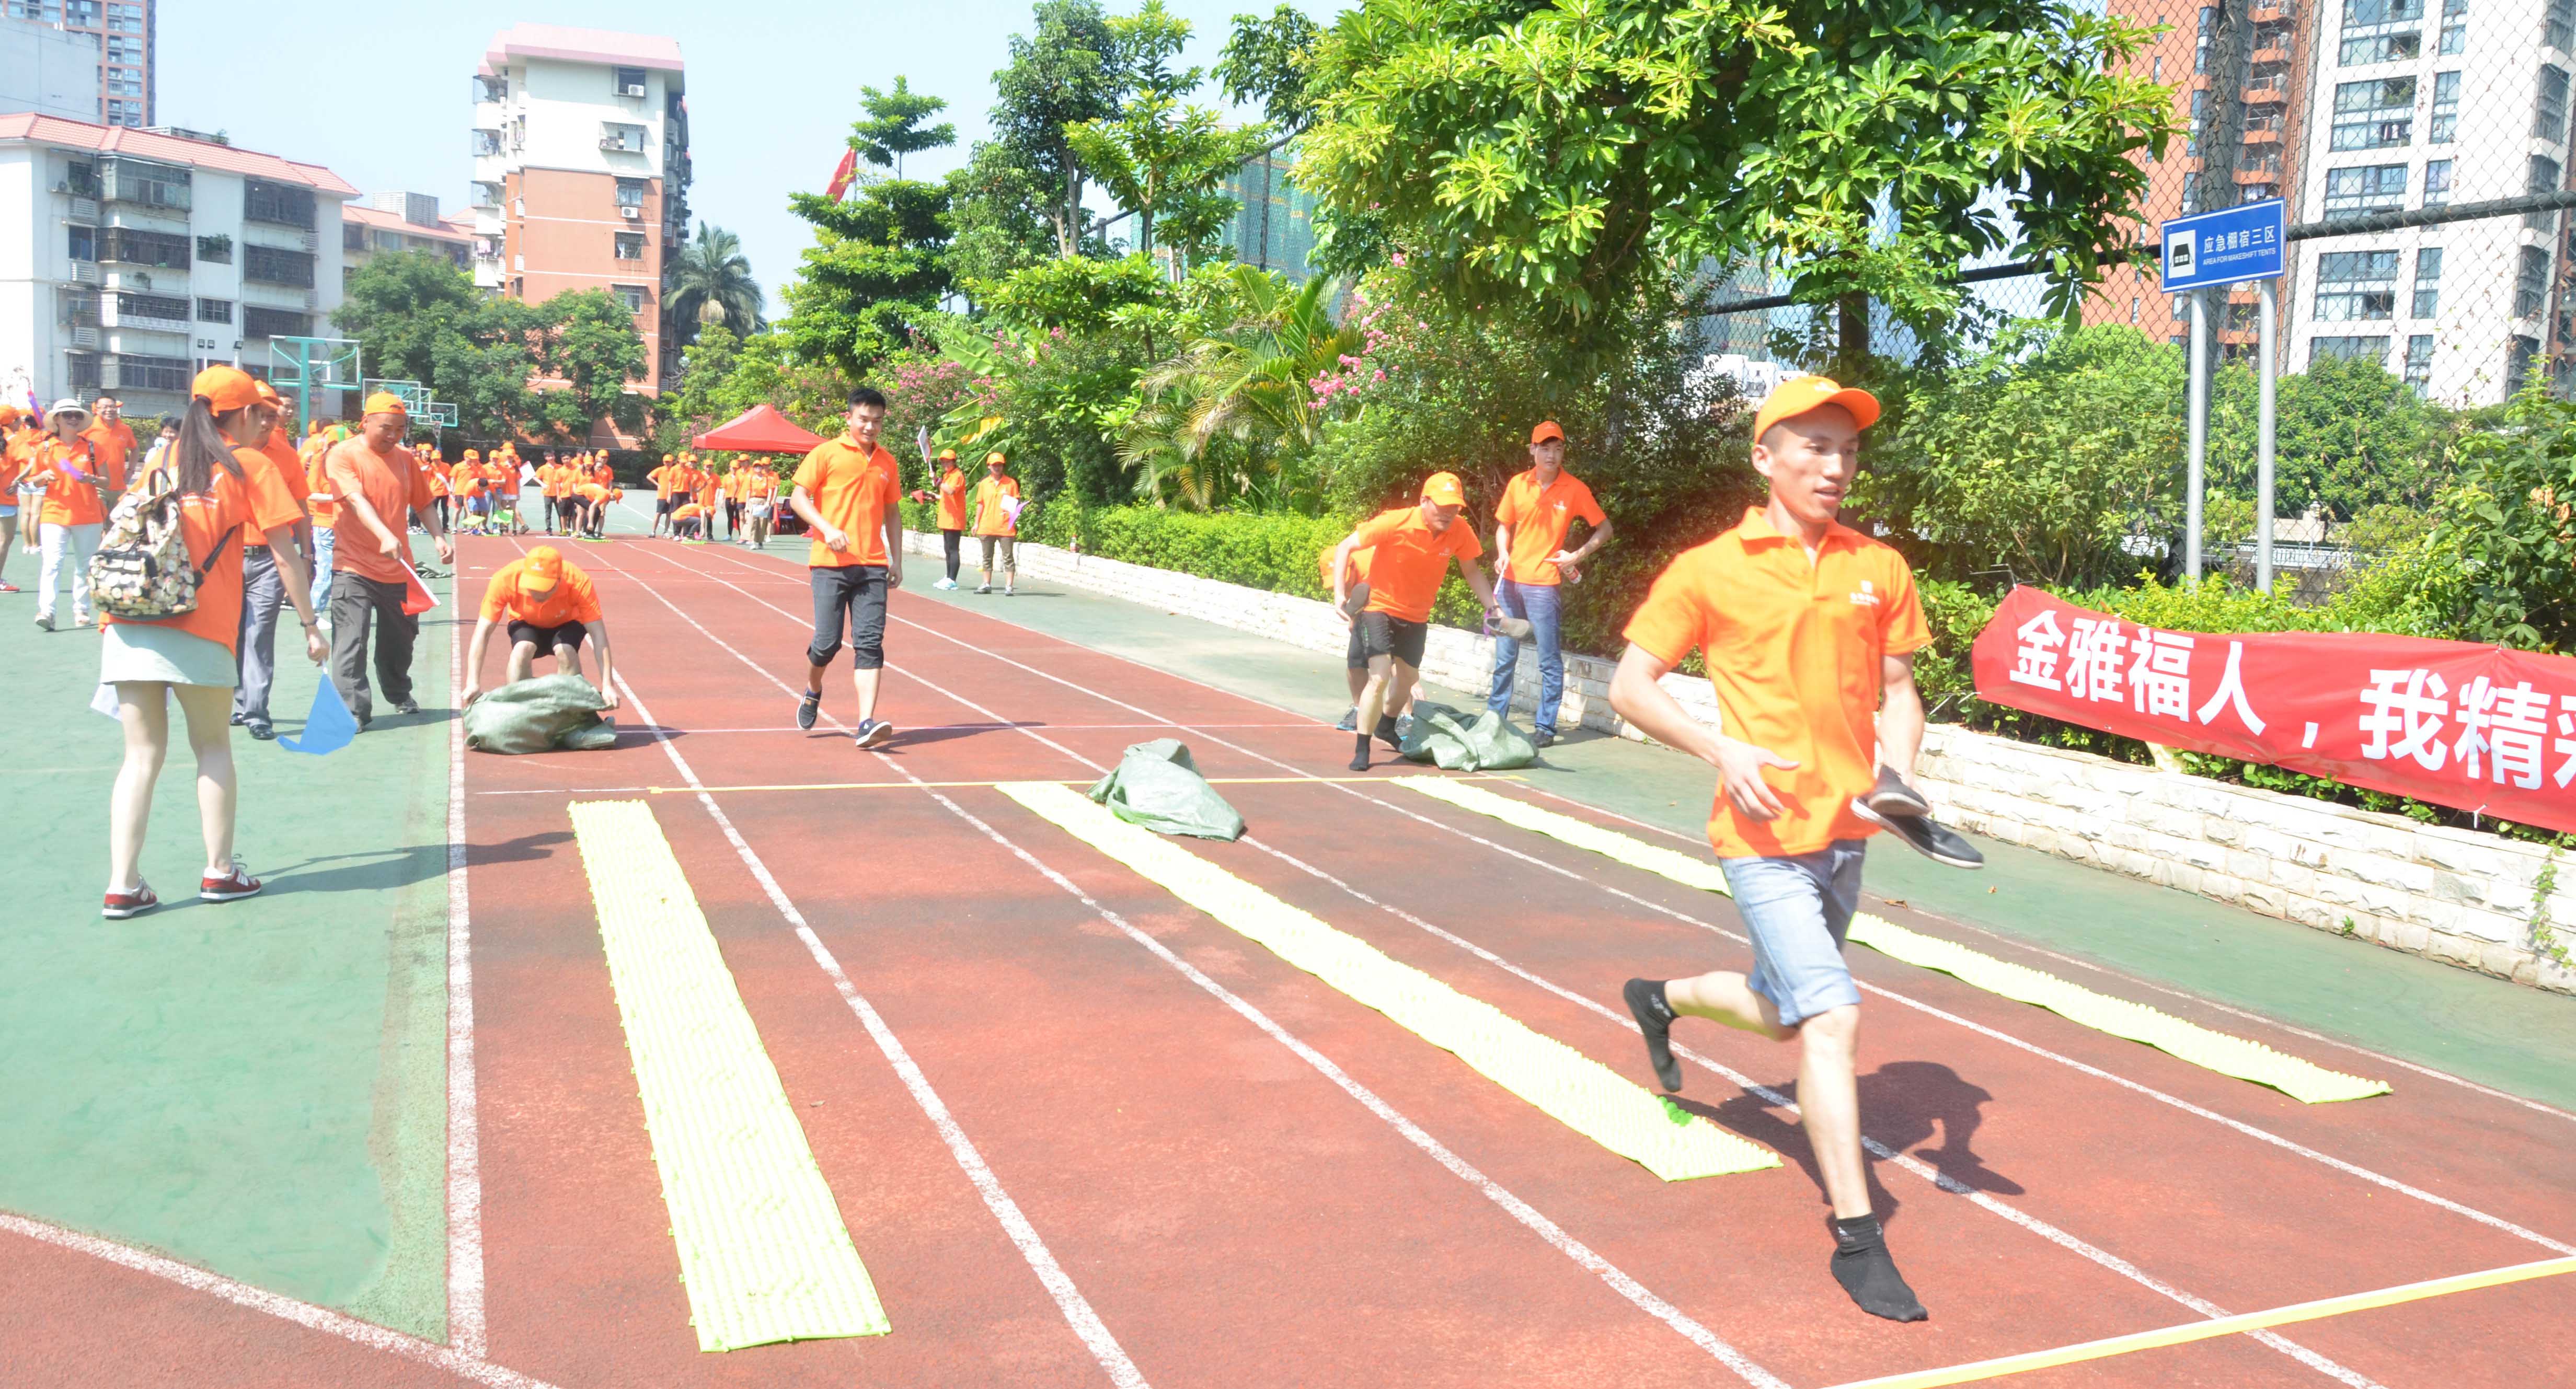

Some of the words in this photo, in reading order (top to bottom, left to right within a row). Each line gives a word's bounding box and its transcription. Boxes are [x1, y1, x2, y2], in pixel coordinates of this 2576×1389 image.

[2203, 225, 2275, 254] 应急棚宿三区
[2216, 255, 2227, 263] FOR
[2228, 250, 2257, 261] MAKESHIFT
[2256, 248, 2276, 257] TENTS
[2010, 610, 2576, 790] 金雅福人，我精
